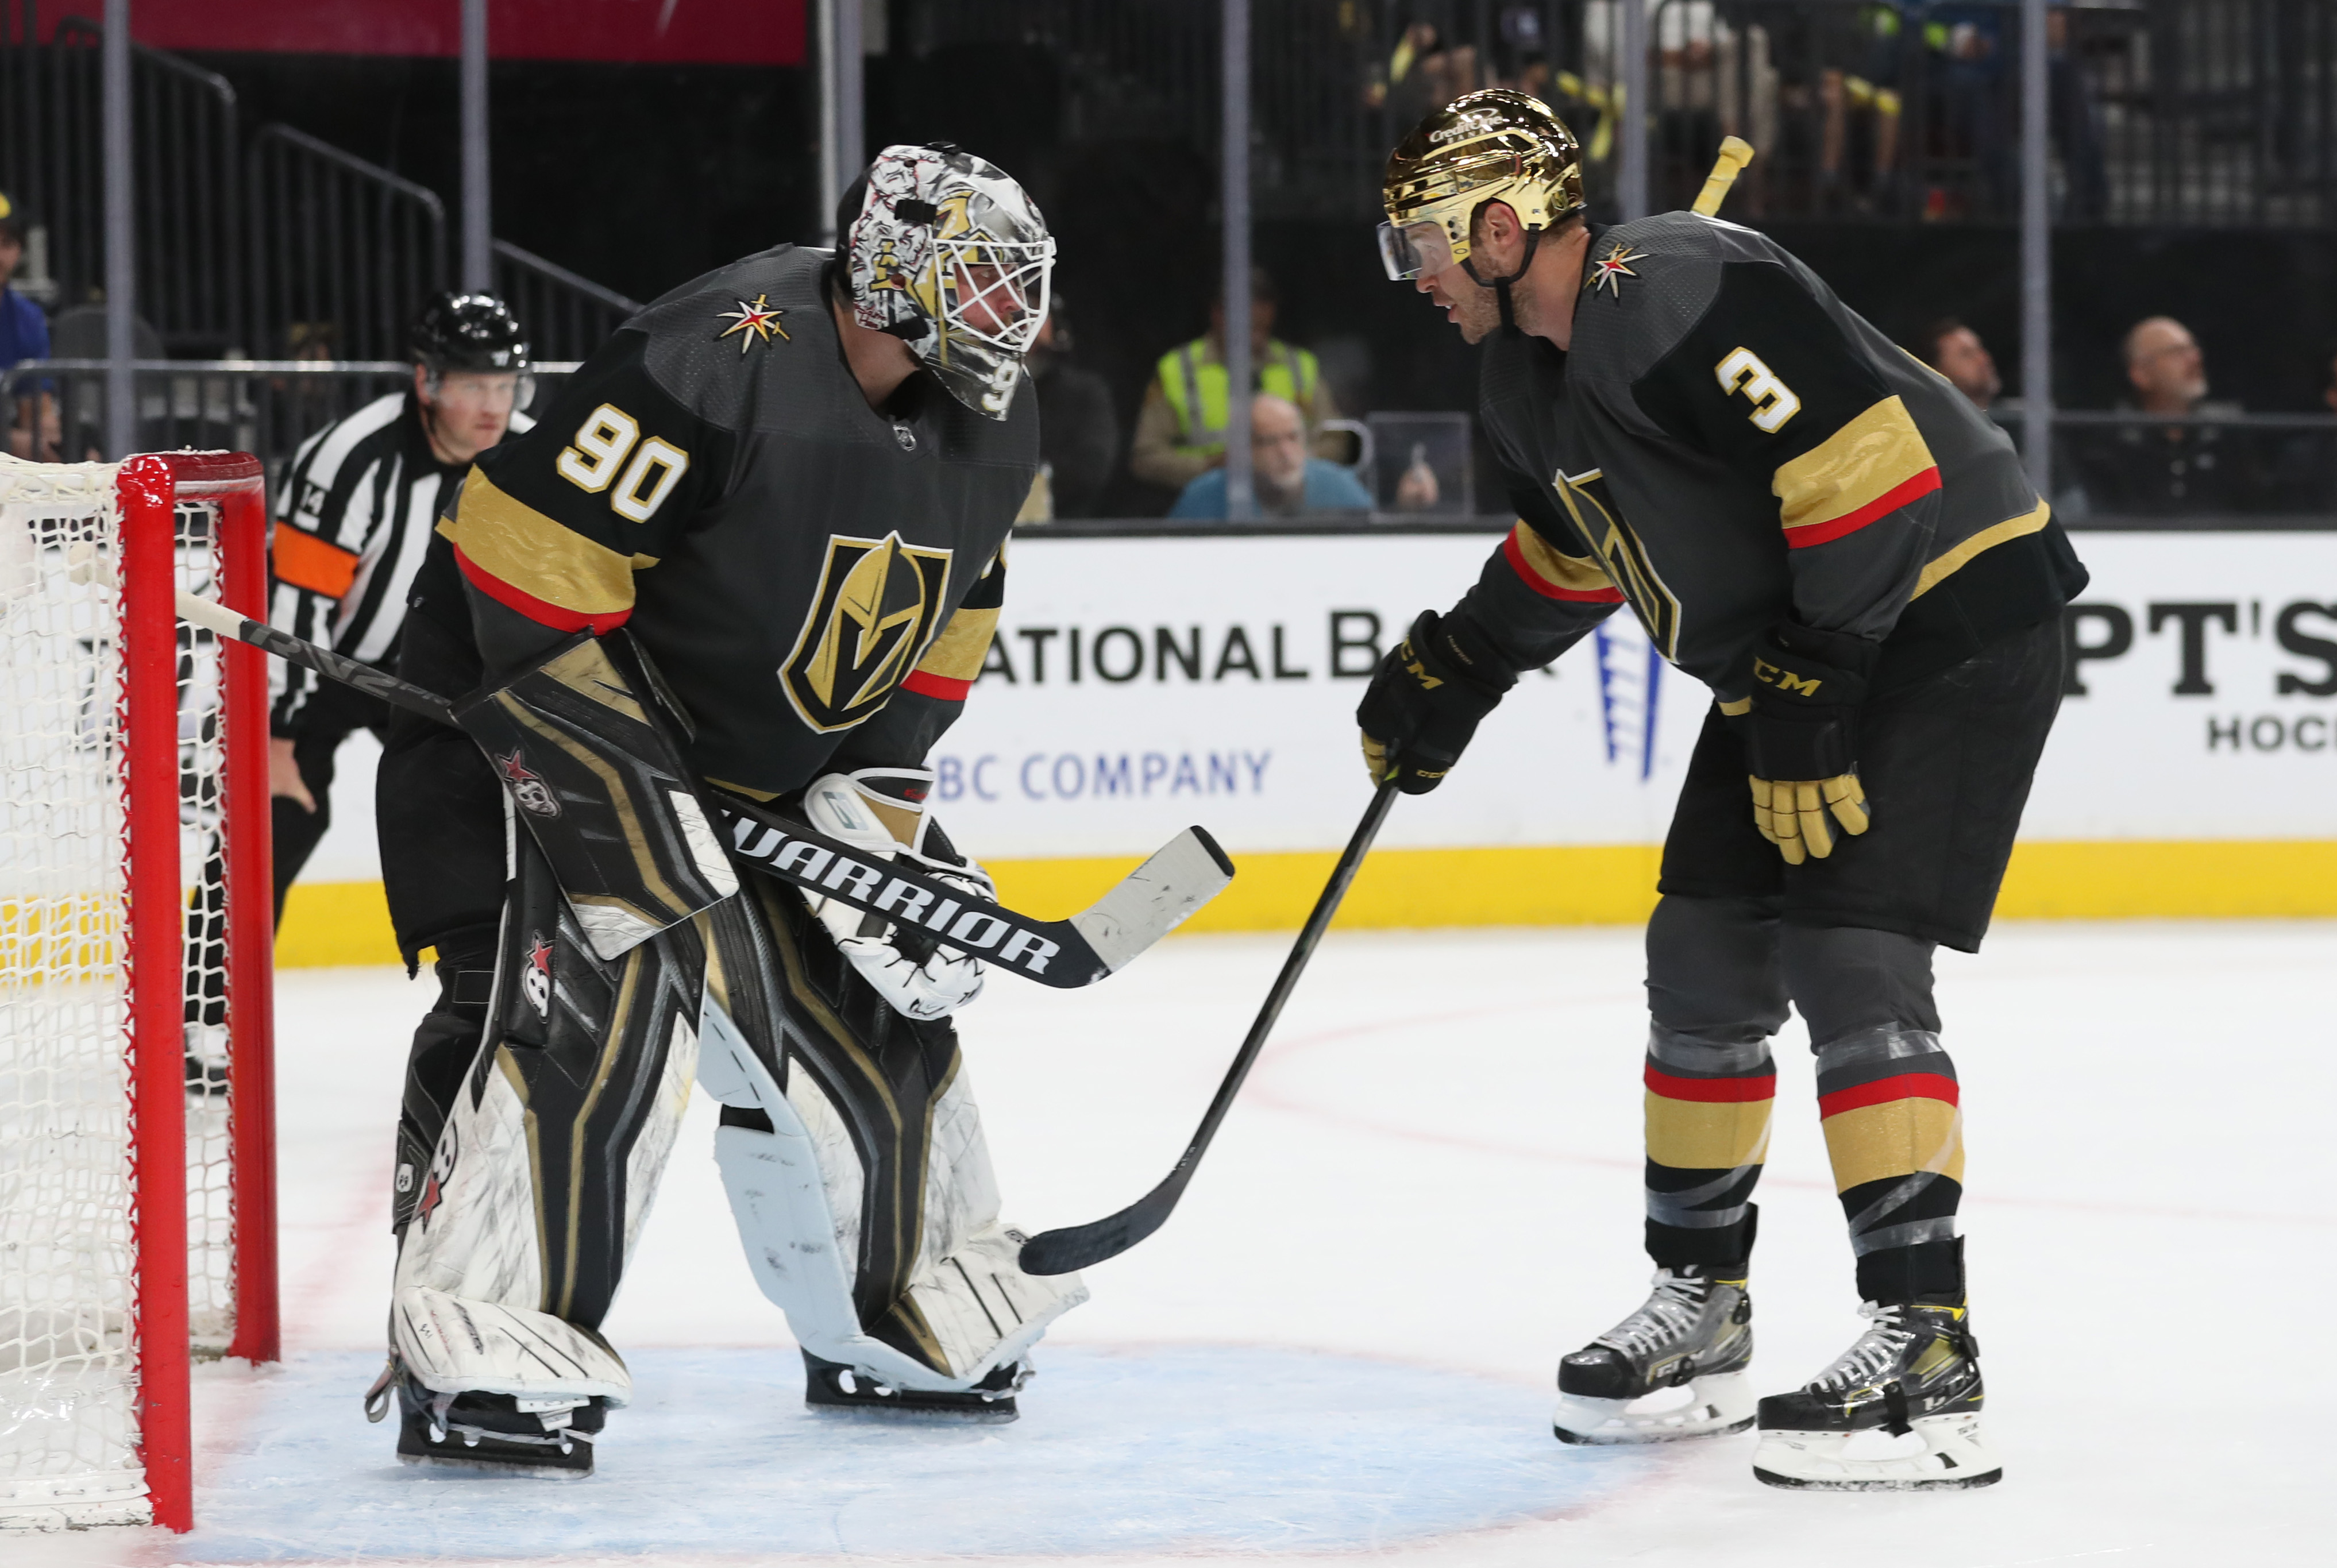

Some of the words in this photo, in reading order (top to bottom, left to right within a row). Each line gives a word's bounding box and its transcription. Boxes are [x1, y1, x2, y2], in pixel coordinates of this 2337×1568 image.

[1714, 346, 1802, 434] 3
[556, 402, 689, 524] 90
[1400, 634, 1444, 690] CM
[1753, 656, 1823, 697] CM
[2062, 601, 2337, 697] PT'S
[2206, 715, 2337, 754] HOC
[1020, 748, 1272, 800] COMPANY
